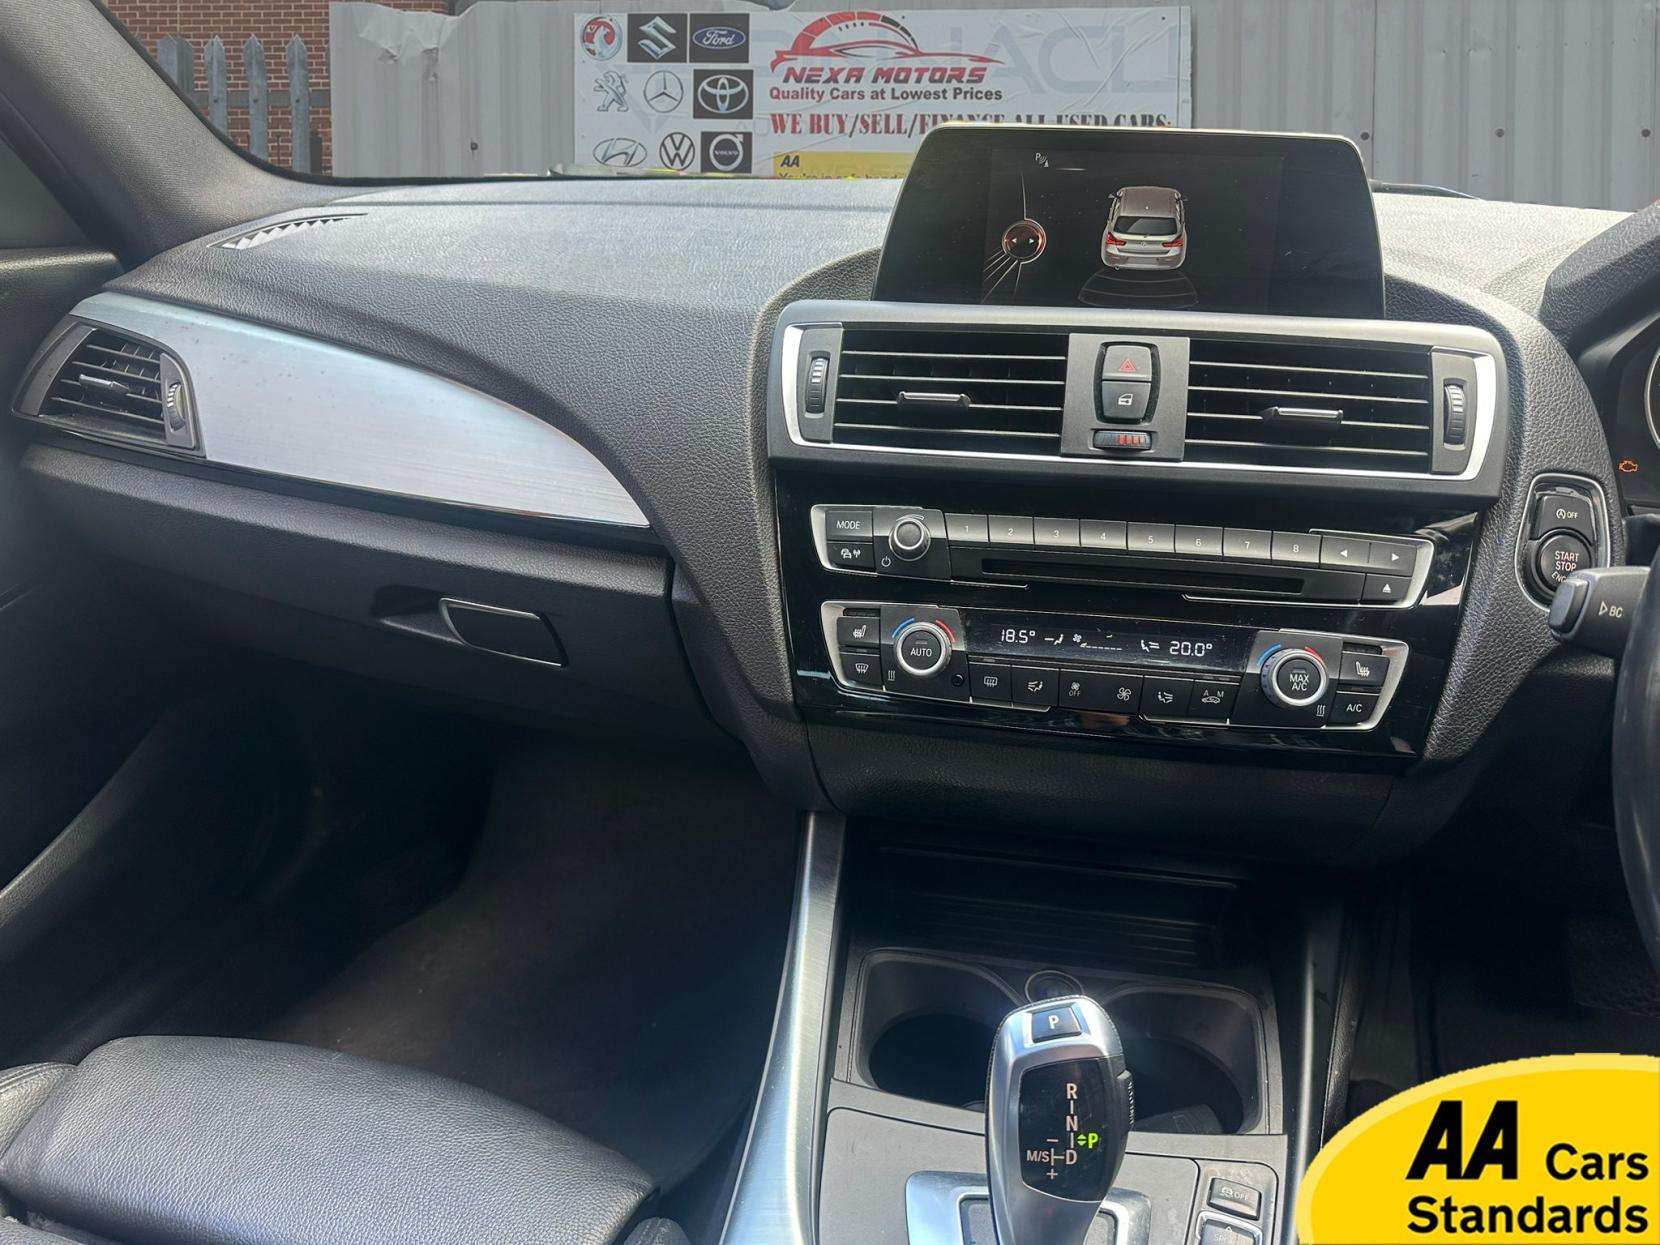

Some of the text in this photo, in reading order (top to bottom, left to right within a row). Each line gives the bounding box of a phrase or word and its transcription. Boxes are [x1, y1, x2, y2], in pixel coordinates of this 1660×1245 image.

[703, 30, 735, 45] Ford
[783, 67, 987, 84] NEXA MOTORS
[769, 86, 1003, 102] Quality Cars at Lowest Prices
[770, 113, 802, 134] WE
[780, 154, 800, 167] AA
[1568, 510, 1578, 519] OFF
[836, 520, 861, 530] MODE
[964, 524, 969, 534] 1
[1008, 527, 1014, 537] 2
[1053, 529, 1059, 539] 3
[1100, 531, 1106, 541] 4
[1147, 536, 1153, 545] 5
[1195, 538, 1202, 548] 6
[1244, 541, 1250, 550] 7
[1293, 544, 1299, 554] 8
[1554, 551, 1579, 562] START
[1555, 561, 1577, 571] STOP
[1609, 604, 1623, 618] BC
[910, 647, 933, 658] AUTO
[1289, 674, 1309, 683] MAX
[1291, 682, 1308, 692] A/C
[1068, 690, 1081, 698] OFF
[1346, 701, 1363, 714] A/C
[1049, 1016, 1060, 1030] P
[1066, 1083, 1078, 1100] R
[1066, 1115, 1078, 1132] N
[1087, 1133, 1099, 1148] P
[1026, 1149, 1077, 1166] M/S D
